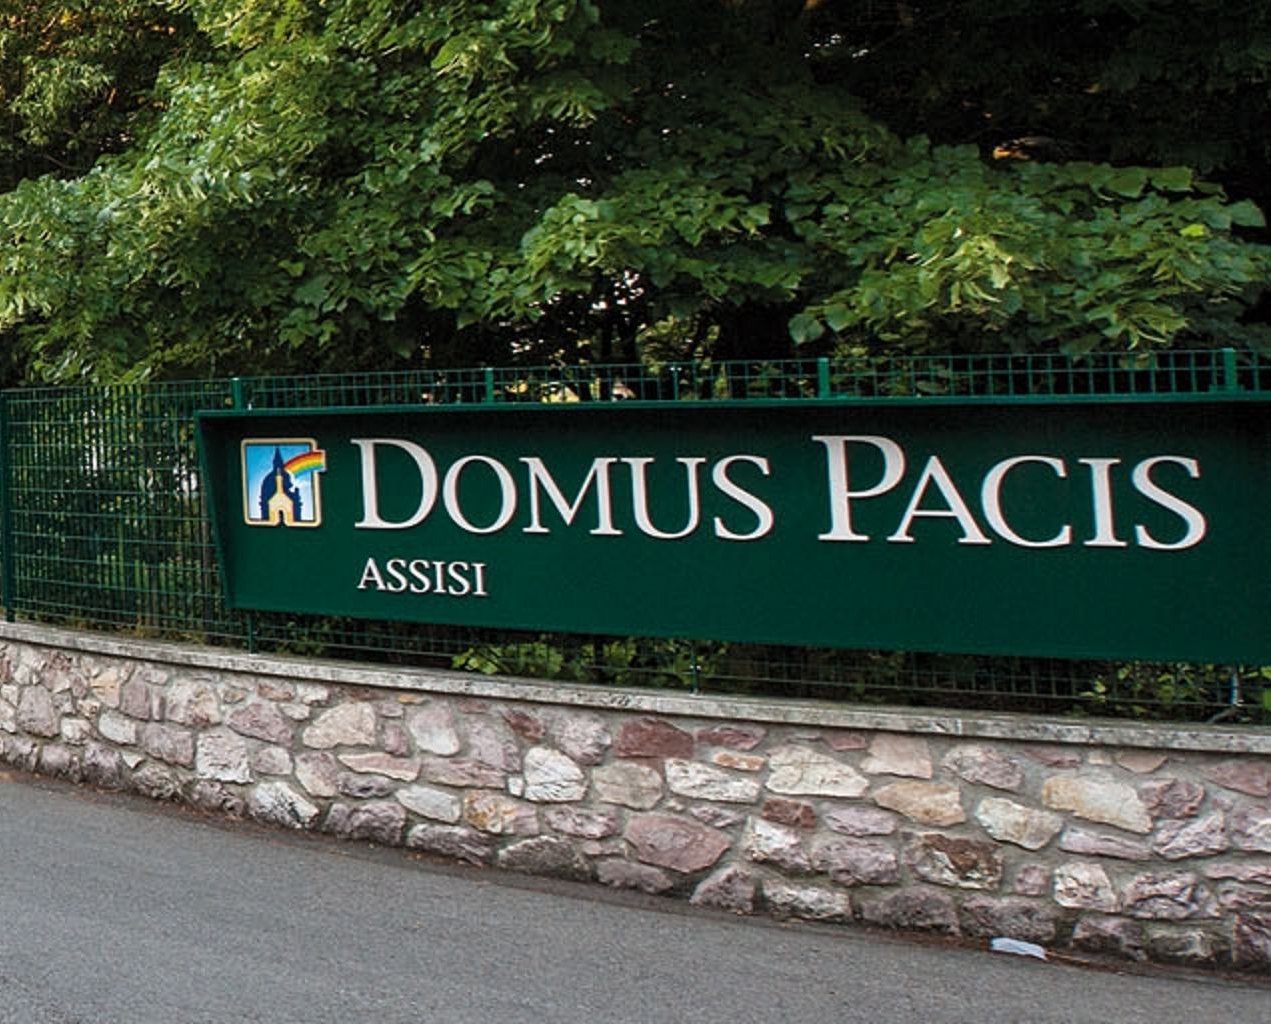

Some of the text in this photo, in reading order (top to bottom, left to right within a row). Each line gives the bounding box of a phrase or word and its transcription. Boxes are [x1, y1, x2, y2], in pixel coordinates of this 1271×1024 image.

[350, 435, 1207, 550] DOMUS PACIS
[357, 557, 488, 597] ASSISI
